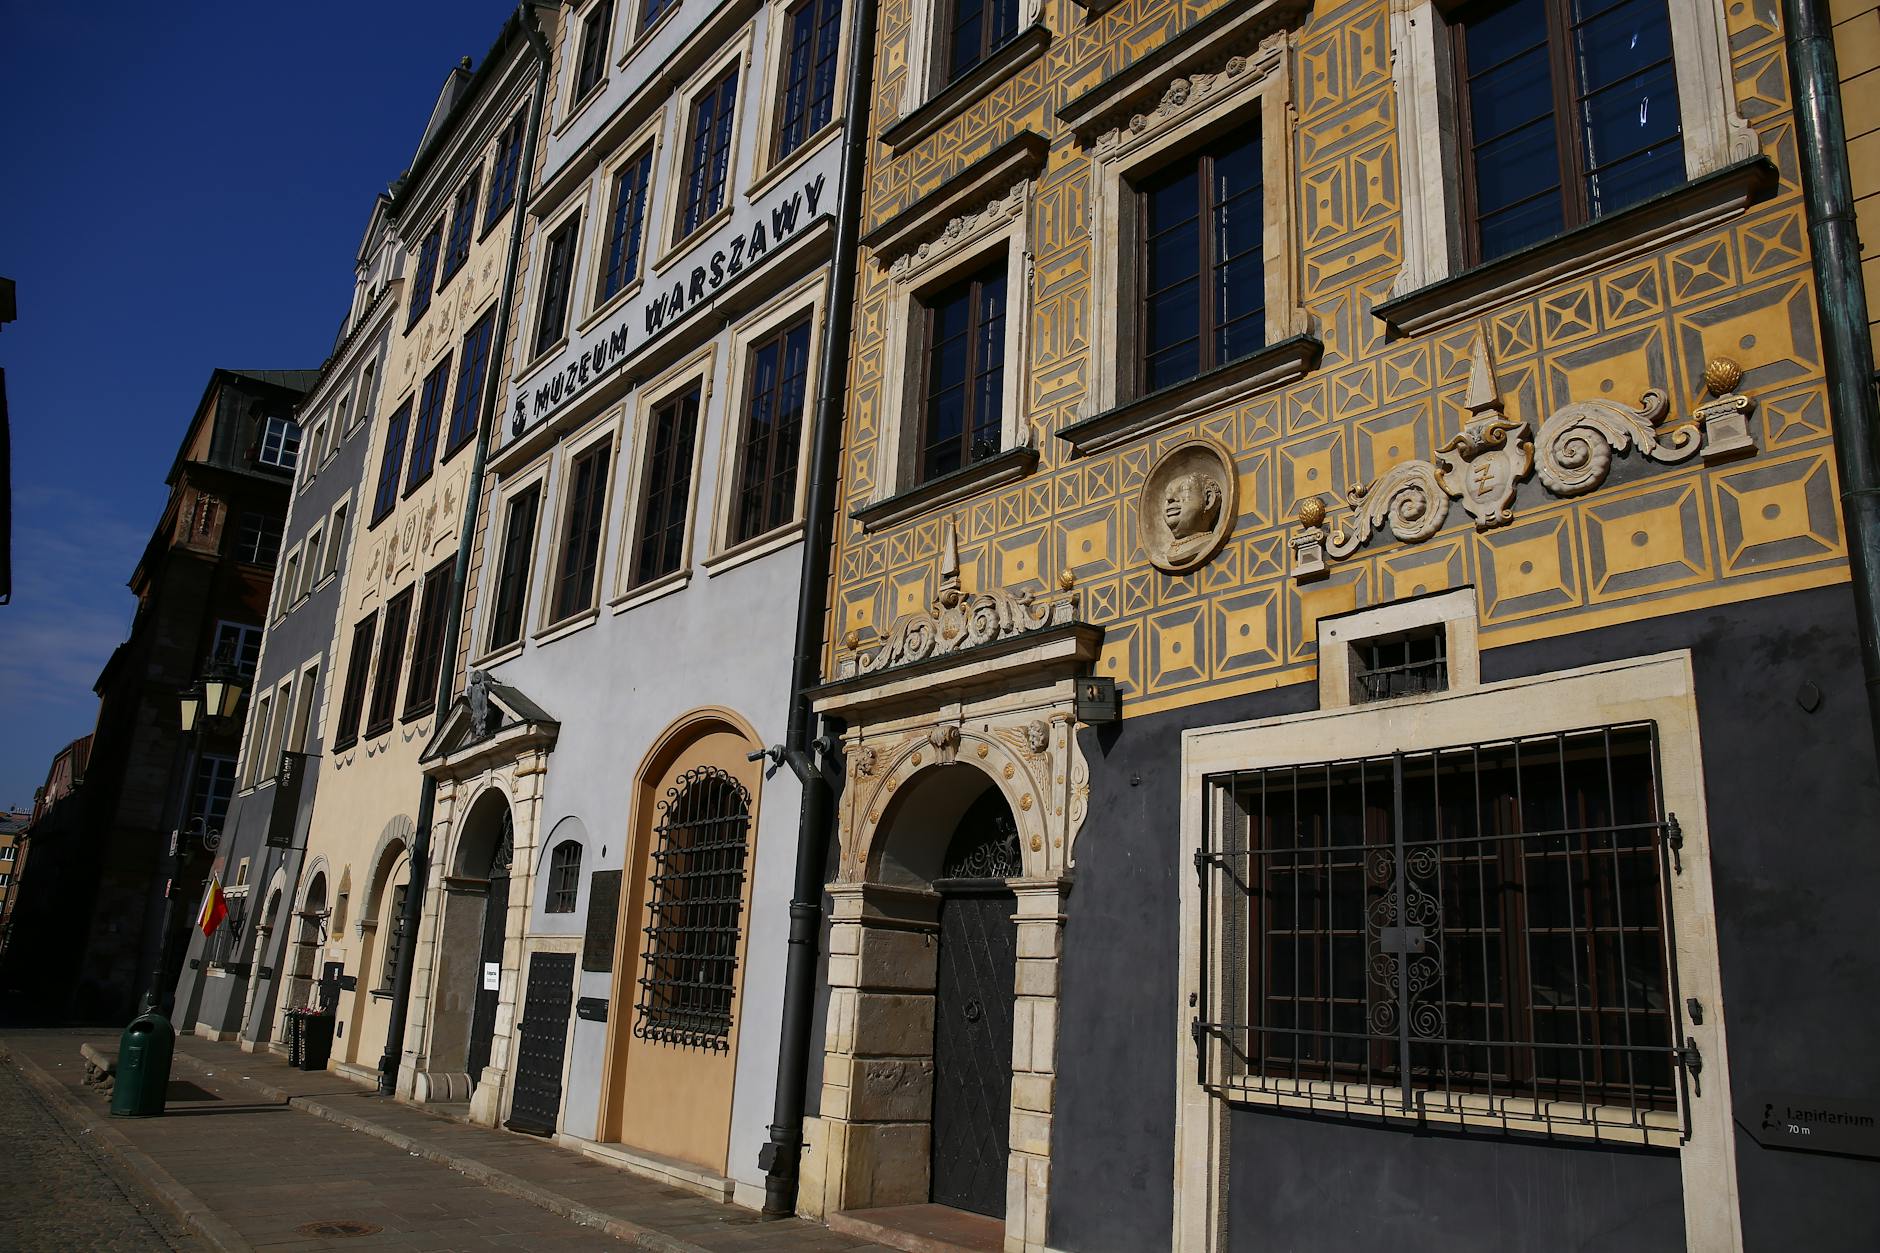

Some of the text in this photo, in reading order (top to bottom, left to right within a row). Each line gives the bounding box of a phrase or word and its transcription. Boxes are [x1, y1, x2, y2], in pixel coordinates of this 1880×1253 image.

[533, 172, 825, 418] MUZEUM WARSZAWY
[1786, 1106, 1874, 1127] Lapidarium
[1788, 1124, 1811, 1135] 70 m
